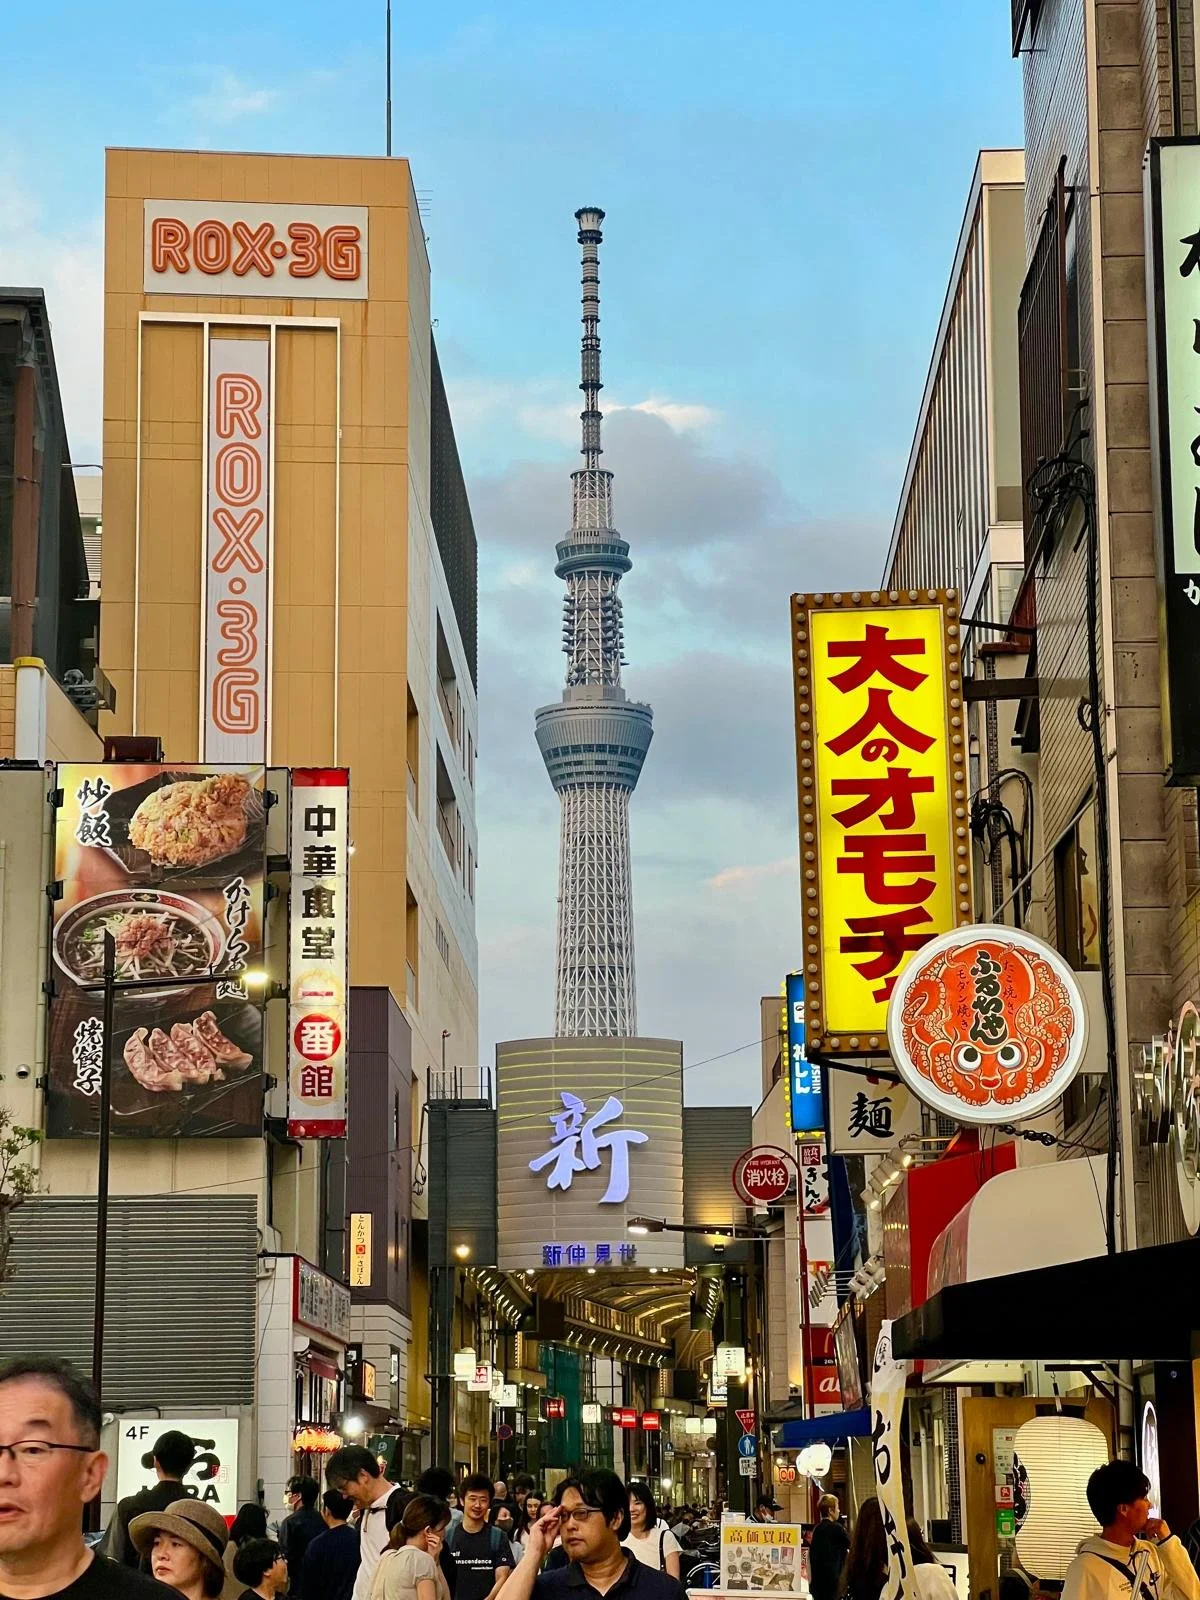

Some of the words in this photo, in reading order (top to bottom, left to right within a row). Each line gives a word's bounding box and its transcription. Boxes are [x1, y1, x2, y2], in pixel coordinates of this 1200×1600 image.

[76, 777, 112, 847] 炒飯
[301, 804, 338, 1098] 中華食堂一番館
[956, 969, 971, 1031] モダン焼き
[1002, 960, 1018, 1016] たこ焼き
[529, 1091, 649, 1204] 新
[746, 1168, 786, 1187] 消火栓
[357, 1214, 365, 1244] とんかつ
[542, 1244, 638, 1266] 新仲見世
[126, 1426, 150, 1440] 4F
[729, 1530, 792, 1544] 高価買取
